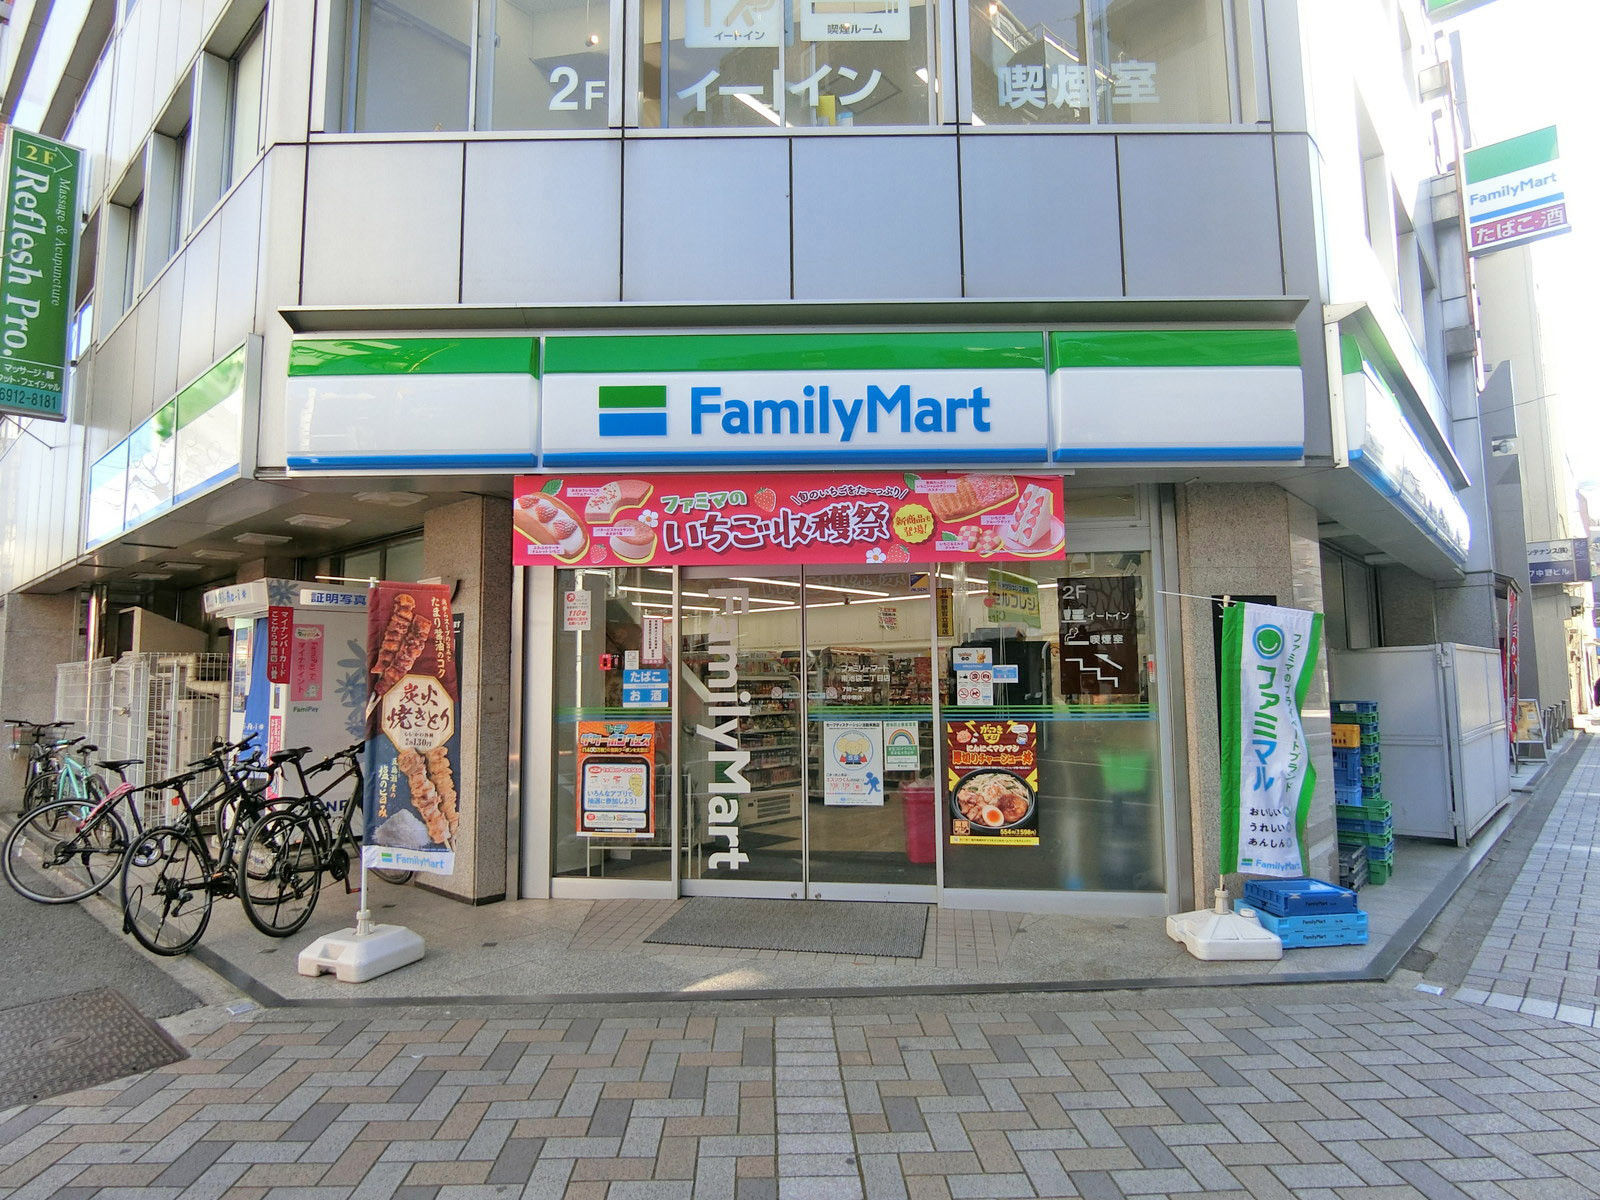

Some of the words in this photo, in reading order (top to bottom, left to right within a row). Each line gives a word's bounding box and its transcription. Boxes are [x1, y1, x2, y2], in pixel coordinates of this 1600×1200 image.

[714, 30, 765, 41] イートイン
[827, 23, 883, 35] 喫煙ルーム
[549, 65, 606, 111] 2F
[997, 59, 1161, 110] 喫煙室
[26, 145, 57, 165] 2F
[1470, 172, 1557, 205] FamilyMart
[56, 178, 71, 221] Massage
[8, 166, 50, 285] Reflesh
[51, 238, 66, 306] Acupuncture
[3, 293, 41, 356] Pro.
[690, 384, 991, 442] FamilyMart
[661, 490, 747, 514] ファミマの
[663, 501, 891, 552] いちご収穫祭
[311, 592, 367, 606] 証明写真
[1062, 585, 1087, 600] 2F
[1087, 612, 1130, 621] イートイン
[1089, 634, 1125, 645] 喫煙室
[630, 671, 662, 683] たばこ
[840, 664, 890, 672] ファミリーマート
[399, 683, 439, 707] 炭火
[696, 587, 752, 870] FamilyMart
[1251, 664, 1281, 792] ファミマル
[1249, 807, 1282, 818] おいしい
[1249, 822, 1286, 833] うれしい
[1247, 838, 1286, 849] あんしん
[396, 853, 445, 869] FamilyMart
[1255, 858, 1301, 872] FamilyMart
